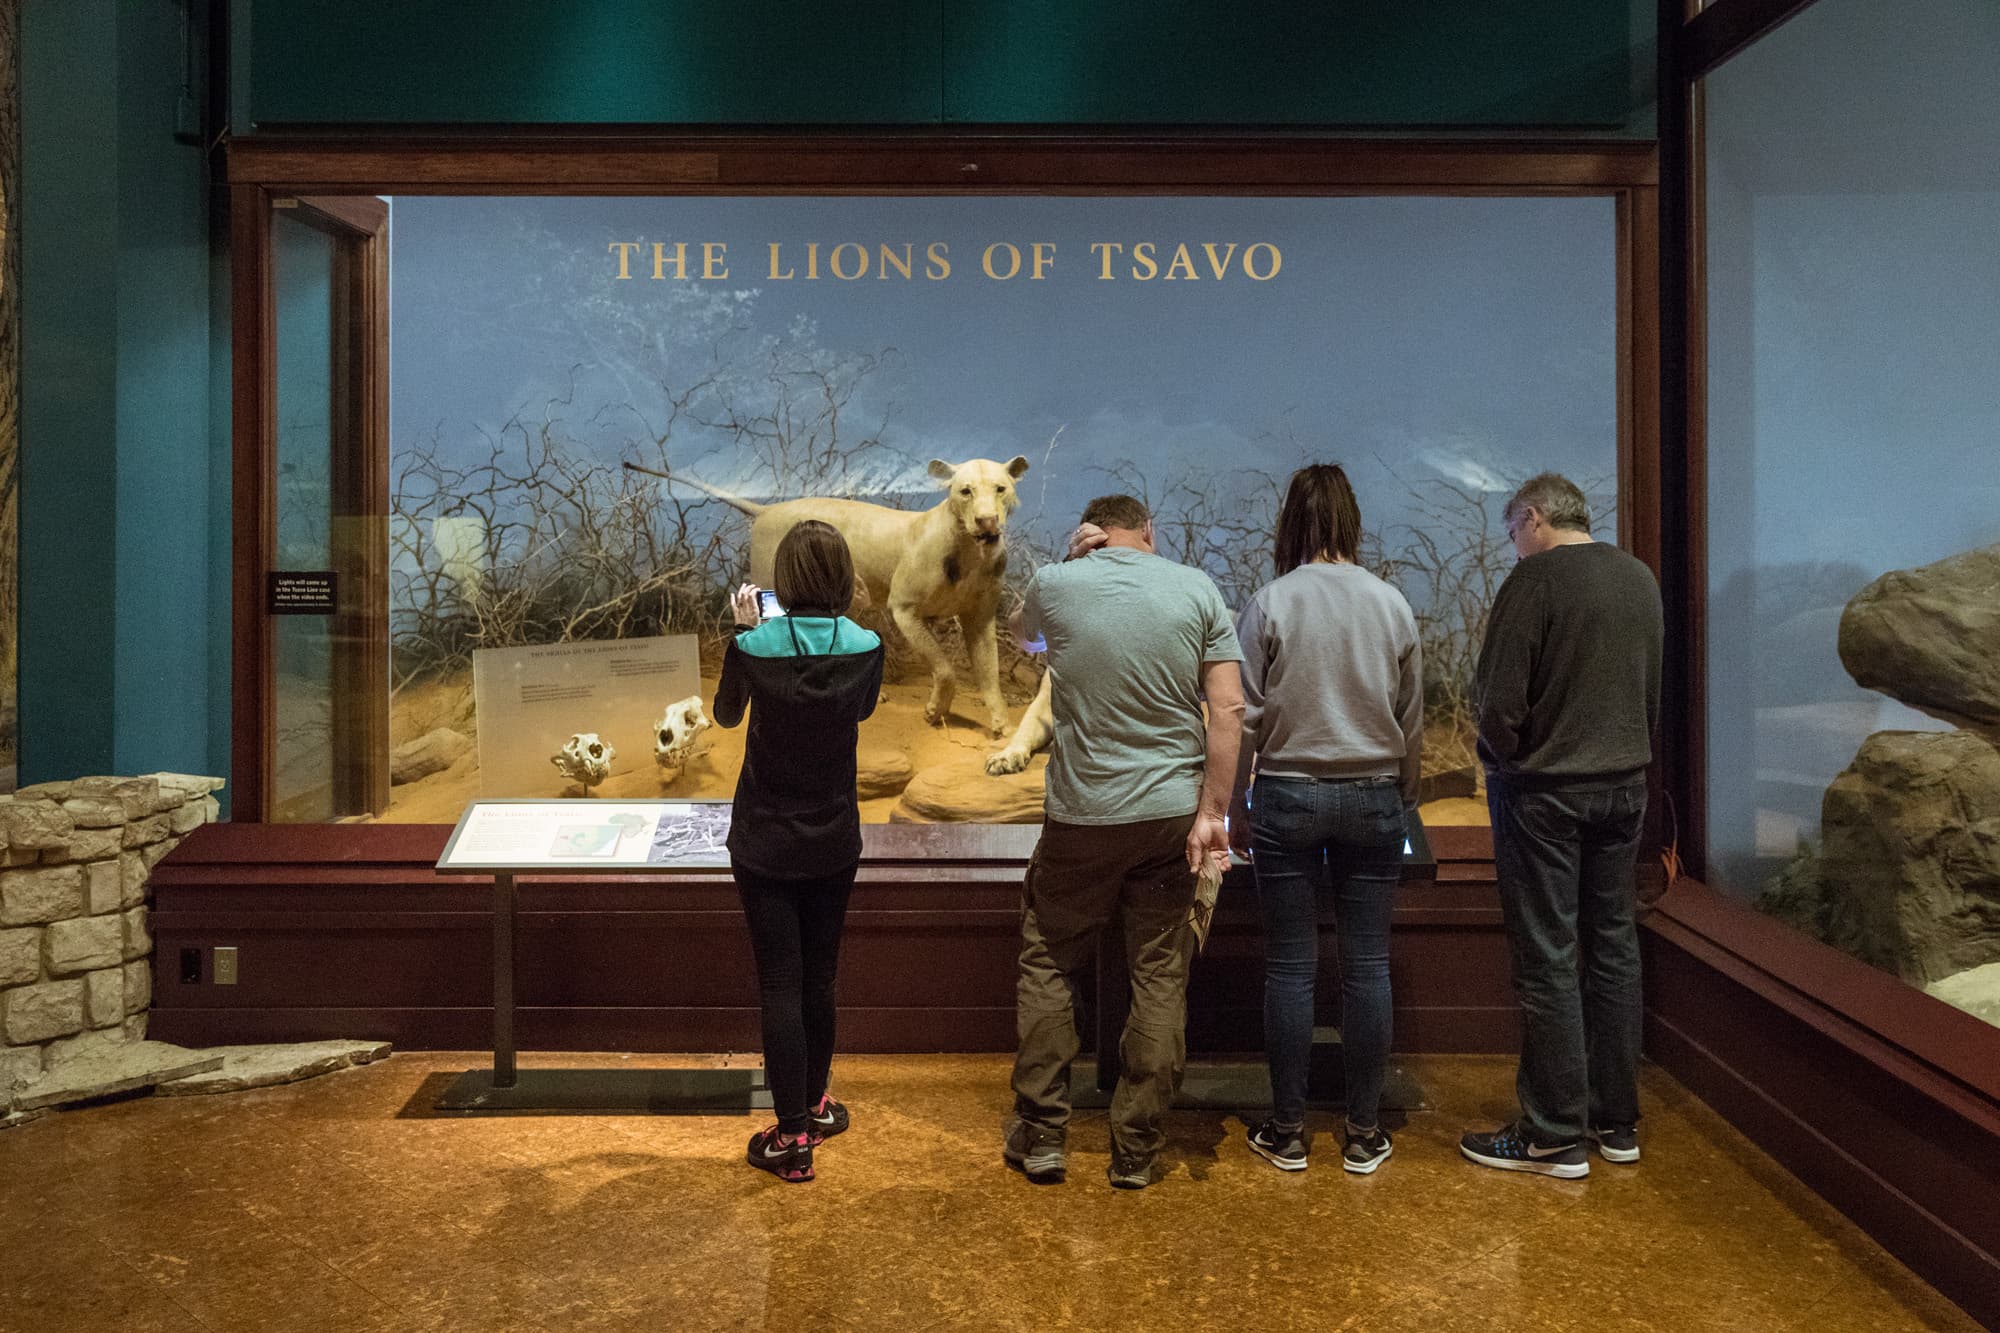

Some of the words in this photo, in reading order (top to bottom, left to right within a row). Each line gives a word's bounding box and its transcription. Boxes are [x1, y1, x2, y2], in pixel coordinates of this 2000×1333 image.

[608, 242, 729, 280] THE
[766, 242, 952, 280] LIONS
[981, 242, 1057, 280] OF
[1090, 242, 1282, 280] TSAVO
